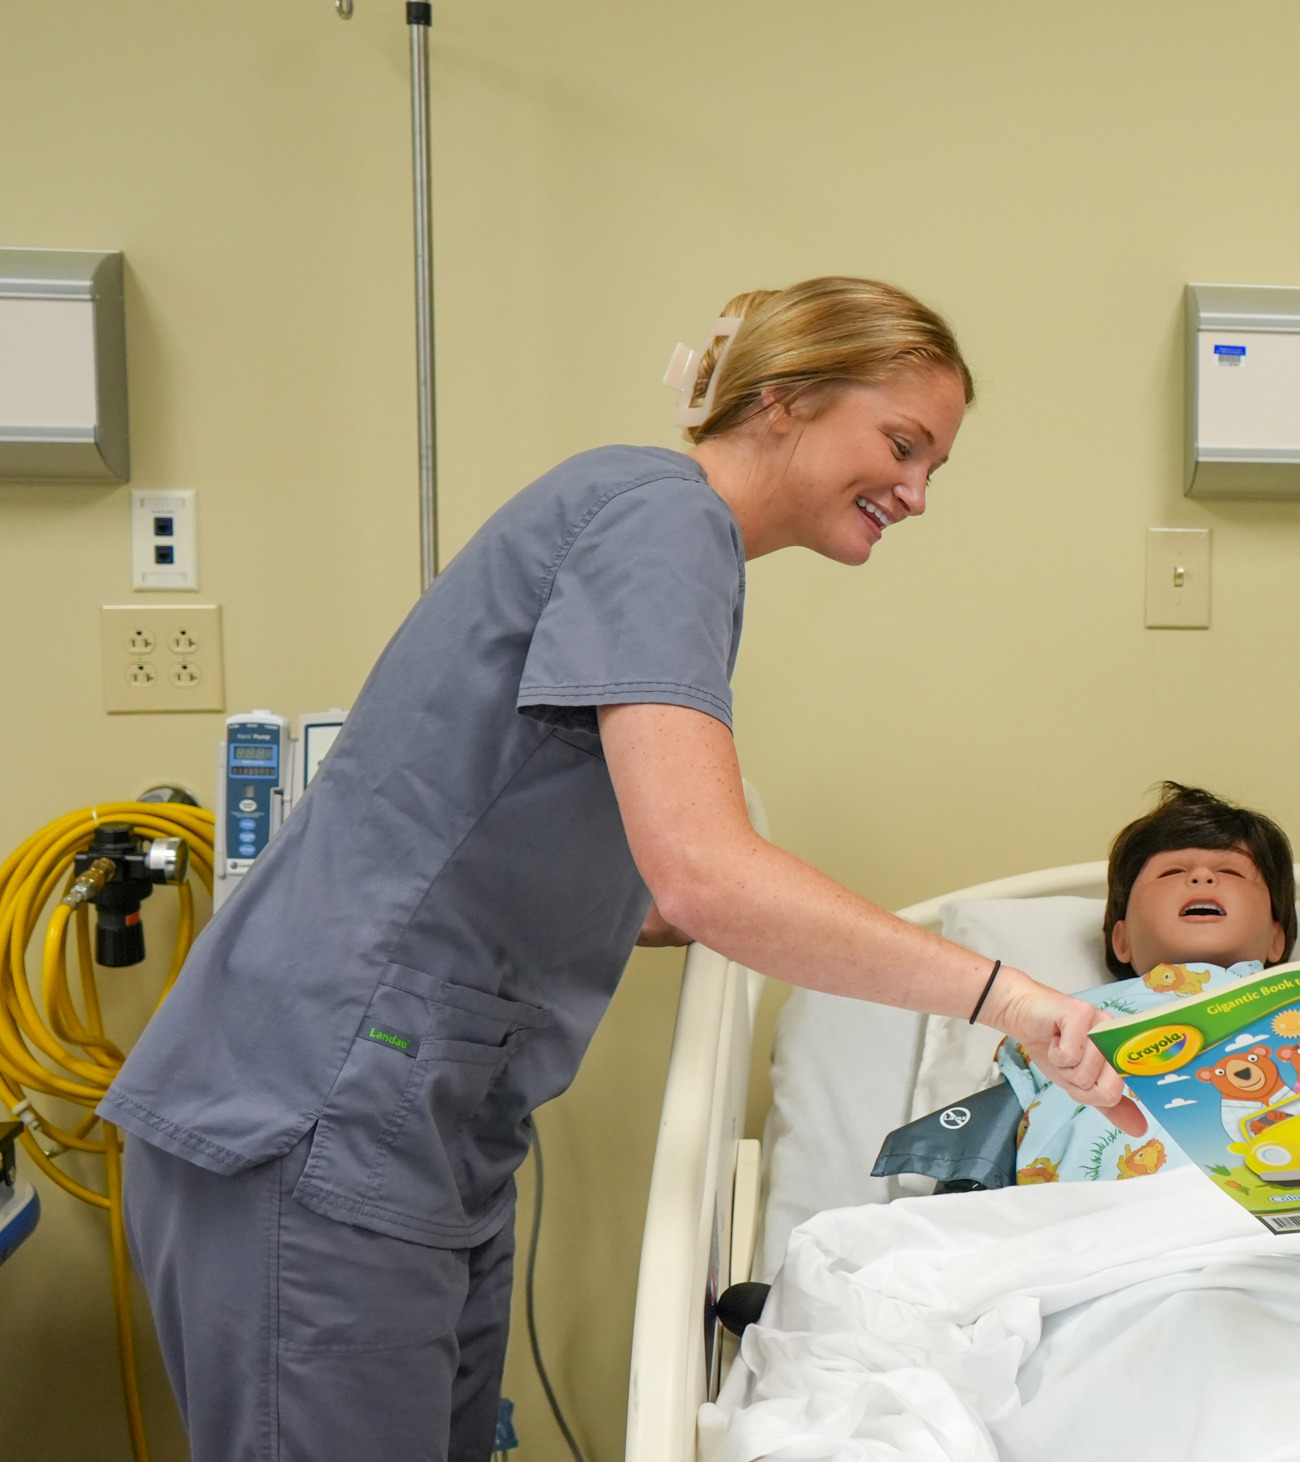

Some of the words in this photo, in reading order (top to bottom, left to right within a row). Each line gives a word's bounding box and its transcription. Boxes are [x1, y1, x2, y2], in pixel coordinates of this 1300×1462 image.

[1206, 991, 1260, 1015] Gigantic
[1260, 980, 1294, 998] Book
[369, 1027, 408, 1049] Landau
[1127, 1031, 1182, 1062] Crayola
